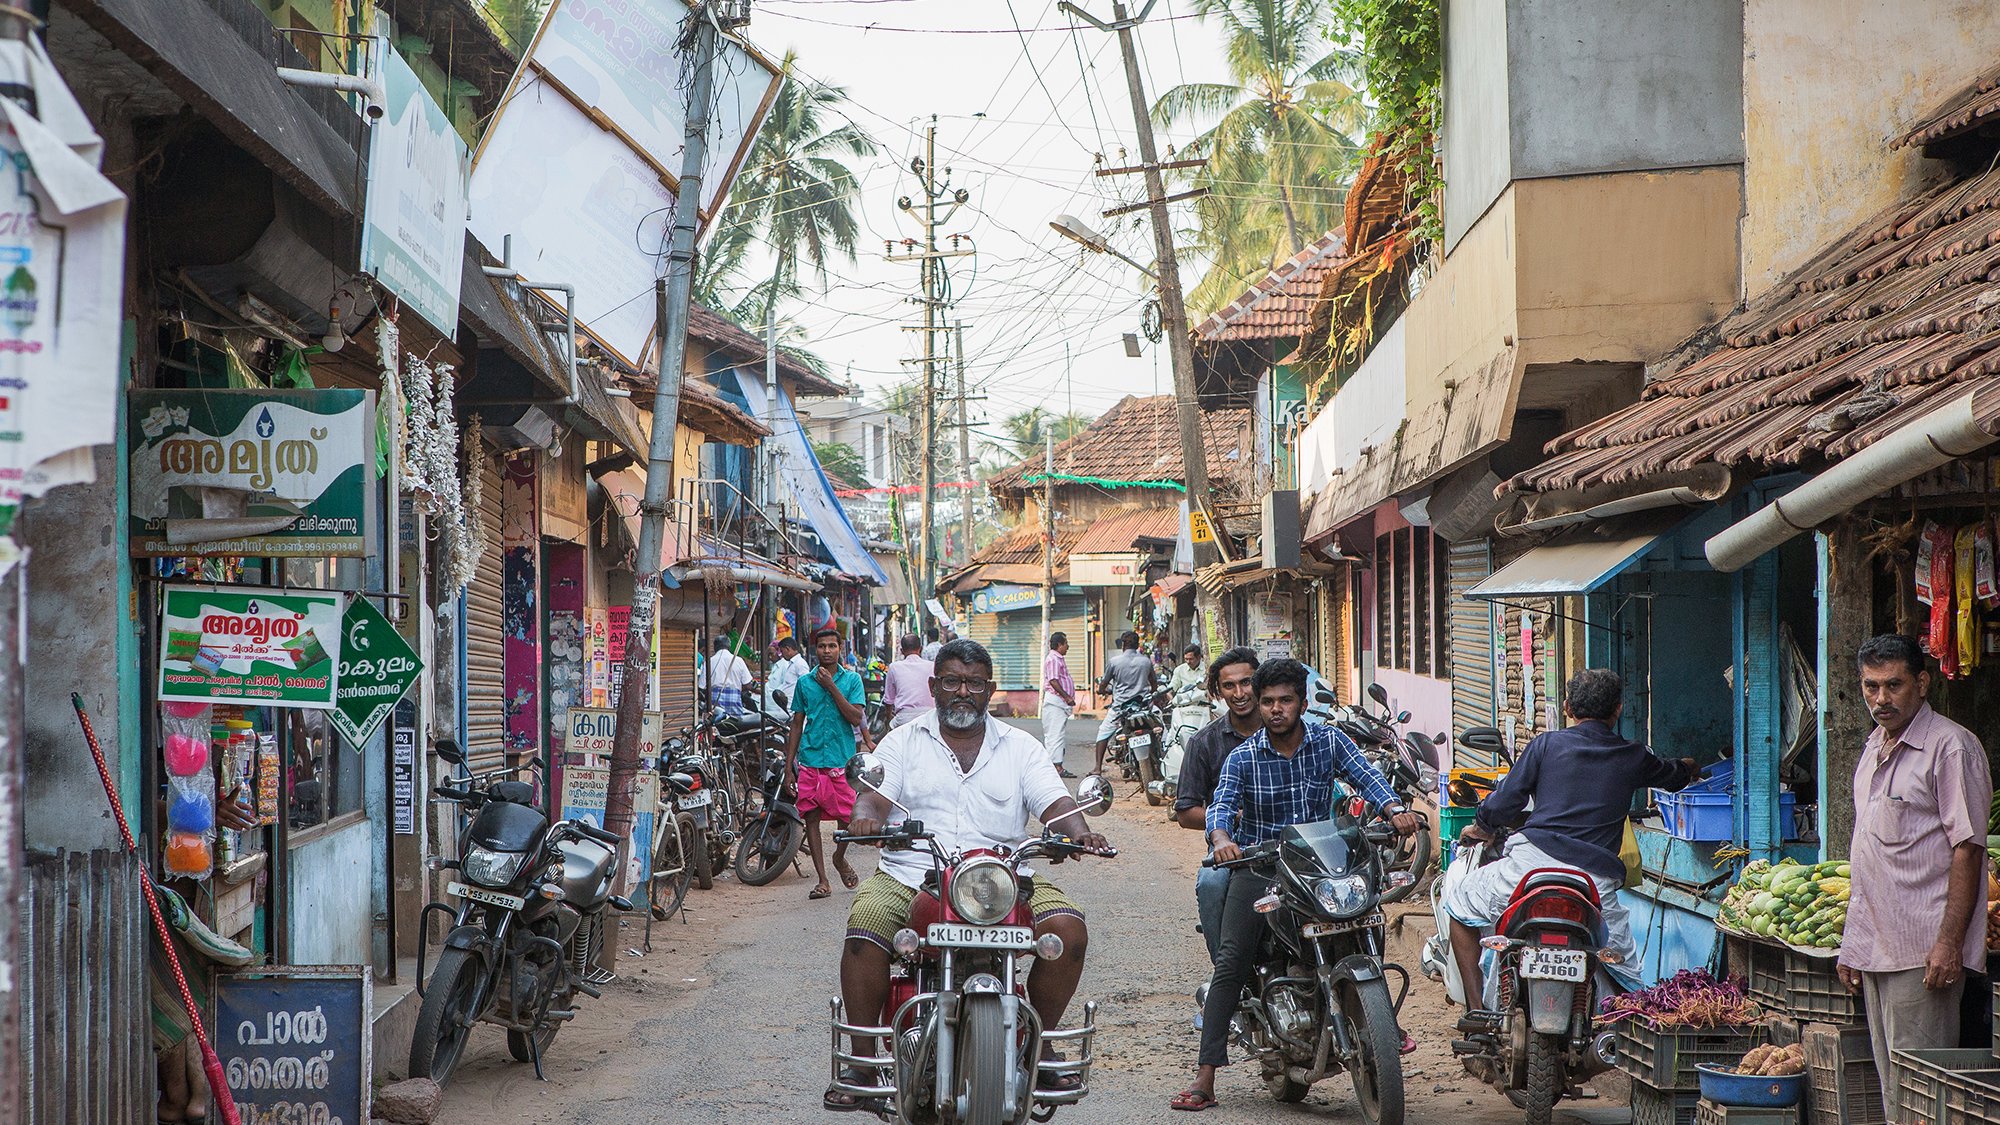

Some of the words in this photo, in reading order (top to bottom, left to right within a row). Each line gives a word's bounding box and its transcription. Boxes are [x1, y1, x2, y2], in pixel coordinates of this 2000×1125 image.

[160, 426, 328, 490] അമൃത്
[1003, 590, 1036, 604] SALOON
[202, 613, 305, 645] അമൃത്
[338, 679, 403, 699] ടൻതൈര്
[1312, 926, 1323, 934] KL
[1535, 953, 1550, 963] KL
[1554, 954, 1572, 965] 54
[1529, 964, 1537, 973] F
[1540, 965, 1578, 977] 4160
[237, 1005, 328, 1046] പാൽ
[226, 1050, 335, 1090] തൈര്
